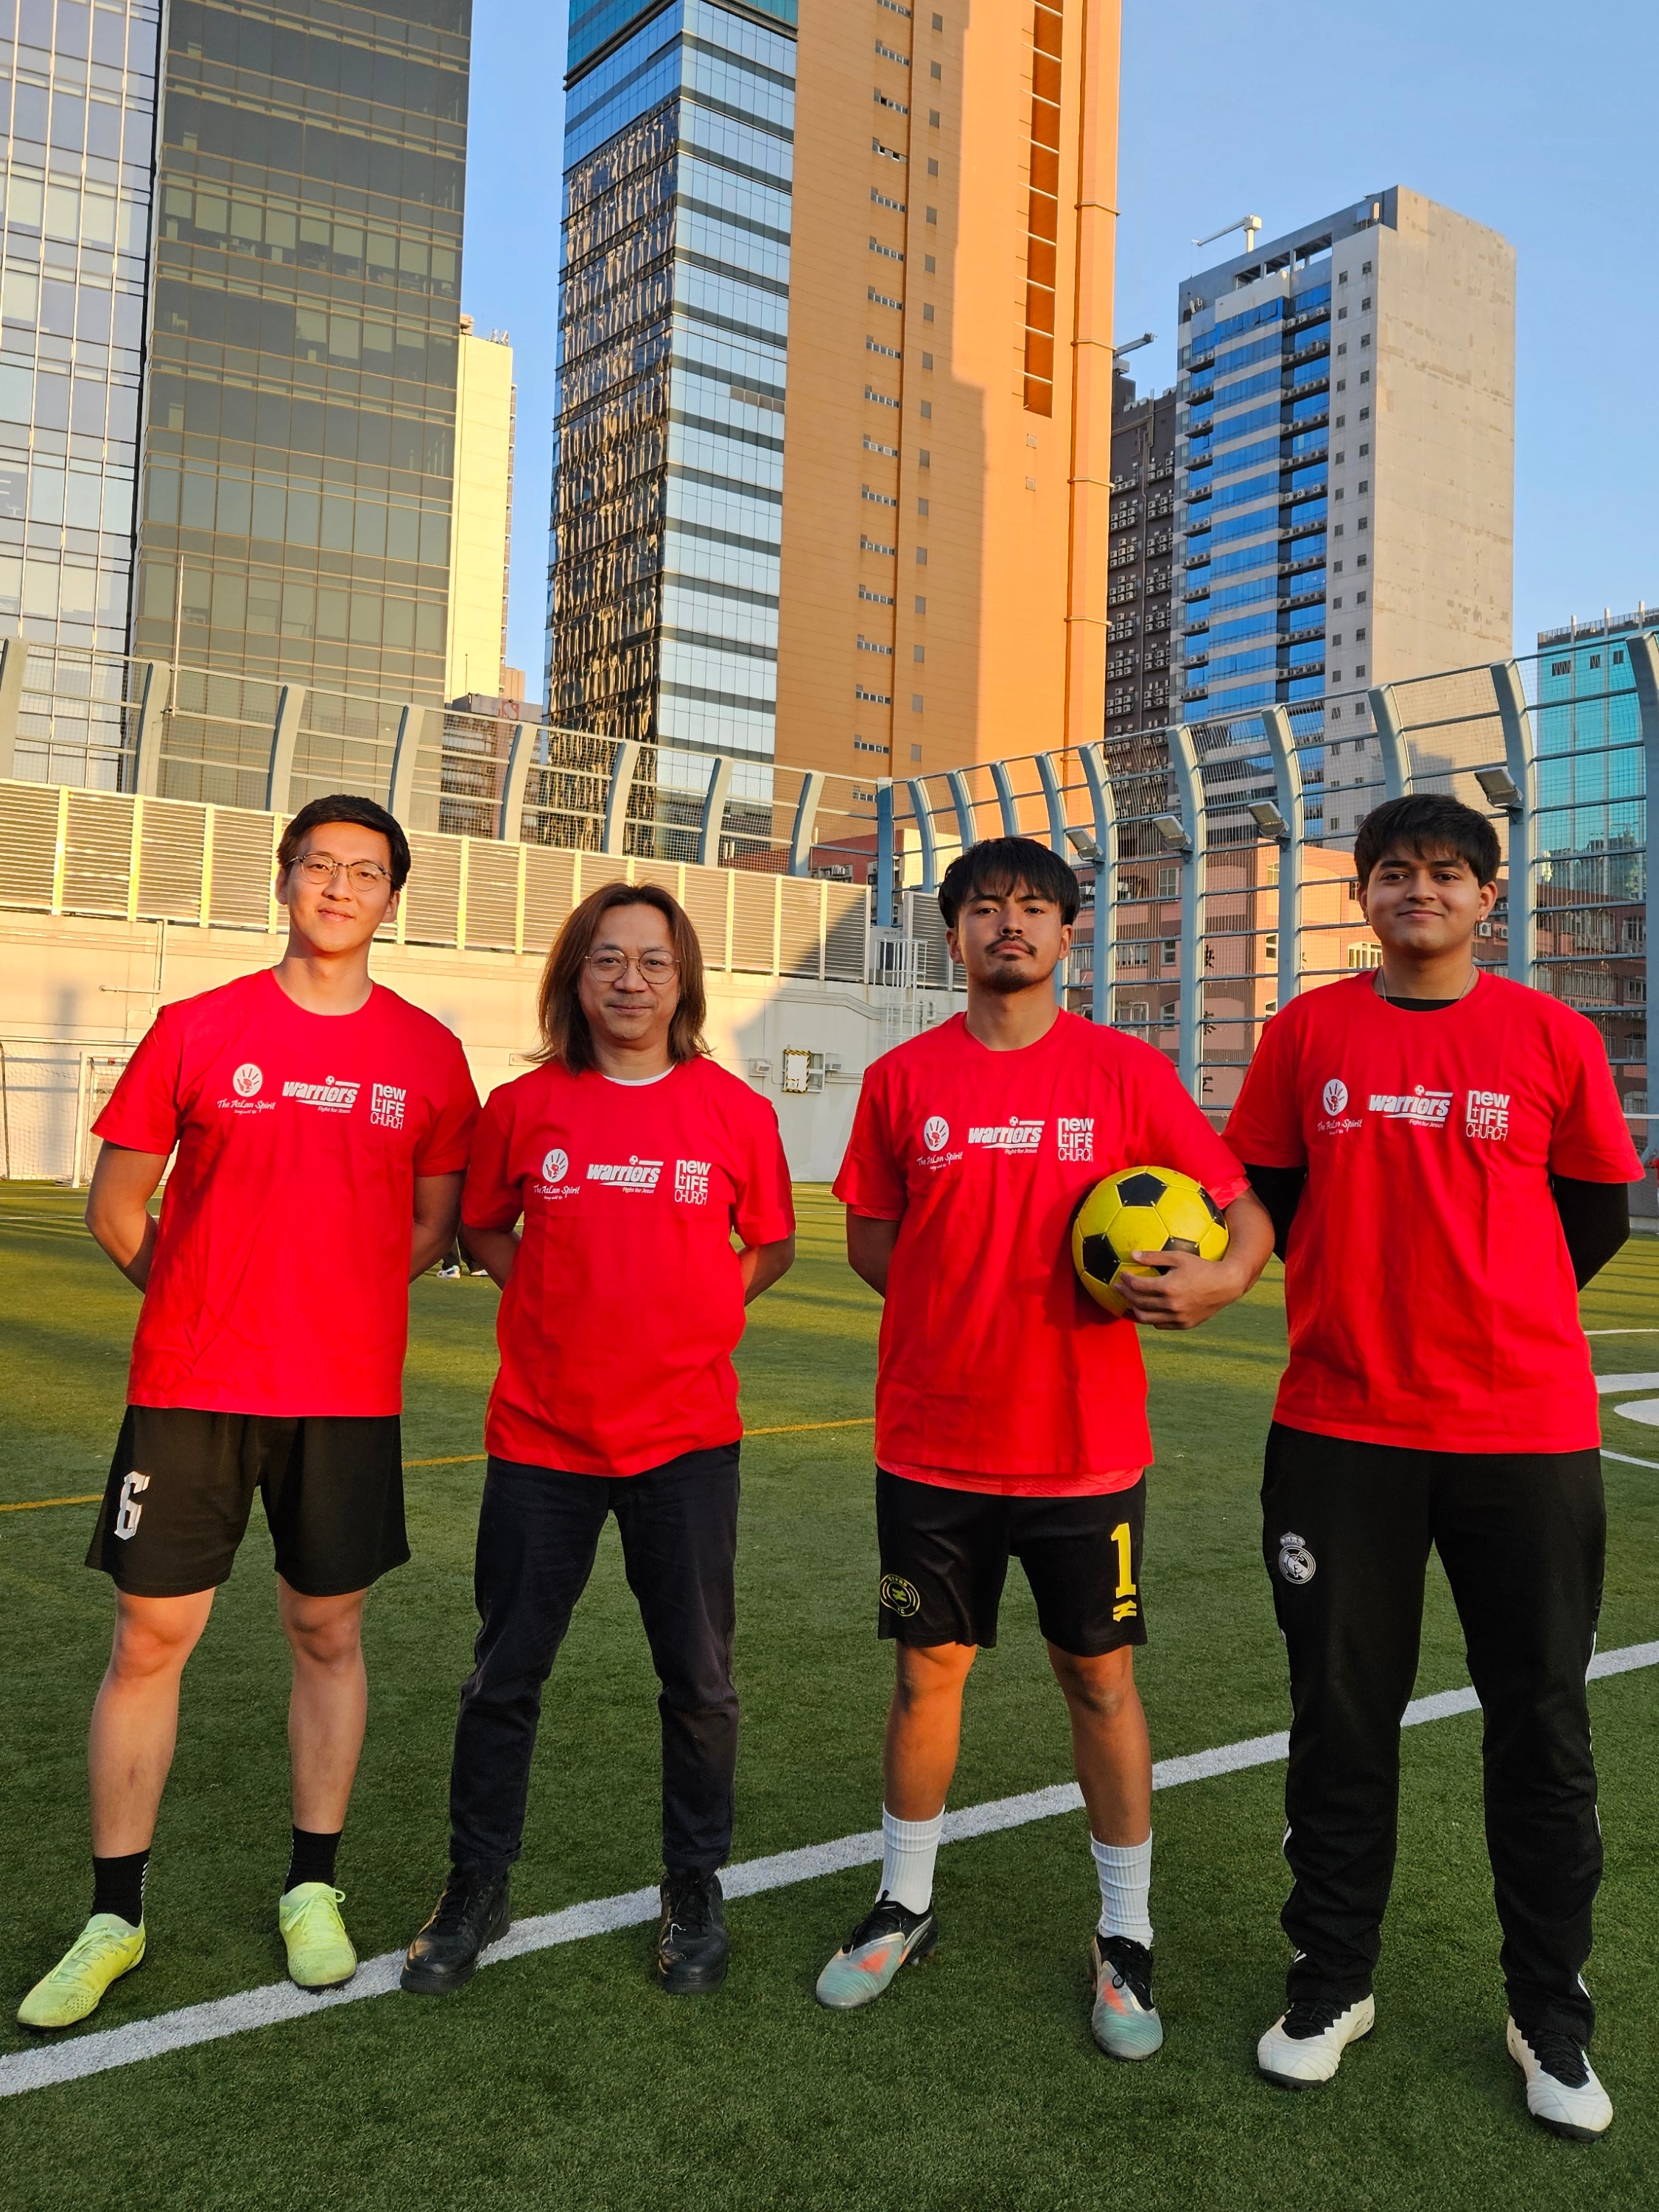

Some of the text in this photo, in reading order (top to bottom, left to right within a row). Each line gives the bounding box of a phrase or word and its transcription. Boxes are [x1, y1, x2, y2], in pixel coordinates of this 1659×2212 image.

[282, 1081, 358, 1103] warriors
[372, 1083, 407, 1101] new
[1467, 1090, 1509, 1109] new
[217, 1098, 230, 1109] The
[255, 1100, 276, 1113] Spirit
[1368, 1095, 1451, 1116] warriors
[370, 1112, 404, 1131] CHURCH
[1058, 1117, 1095, 1131] new
[1317, 1121, 1325, 1131] The
[1341, 1118, 1363, 1132] Spirit
[967, 1127, 1042, 1144] warriors
[1466, 1123, 1508, 1141] CHURCH
[916, 1156, 926, 1166] The
[944, 1151, 964, 1165] Spirit
[1058, 1148, 1093, 1162] CHURCH
[586, 1164, 661, 1183] warriors
[676, 1159, 712, 1176] new
[533, 1184, 541, 1193] The
[561, 1185, 581, 1198] Spirit
[674, 1189, 708, 1206] CHURCH
[114, 1471, 150, 1540] 6
[1111, 1523, 1136, 1598] 1
